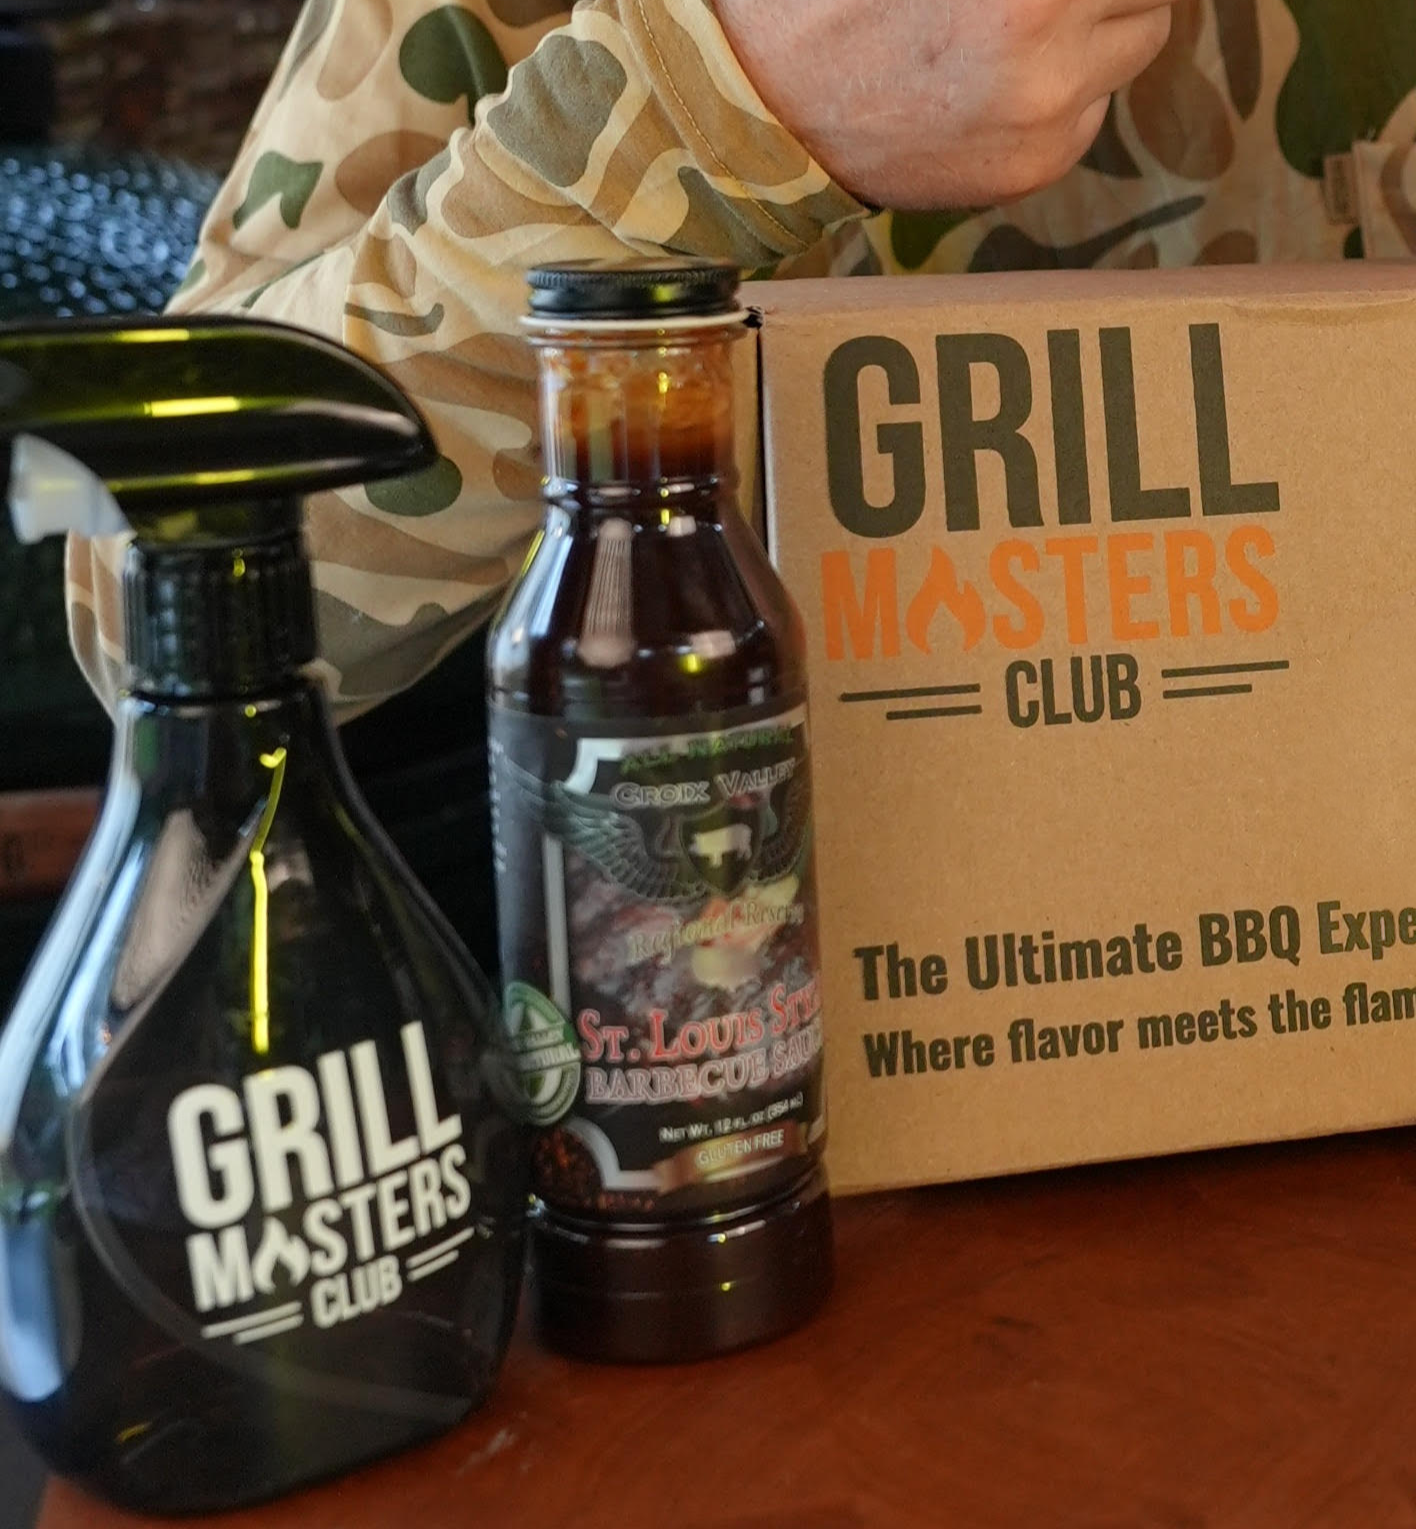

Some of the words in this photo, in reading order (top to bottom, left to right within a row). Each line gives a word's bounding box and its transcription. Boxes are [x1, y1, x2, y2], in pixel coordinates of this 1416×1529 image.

[822, 322, 1280, 539] GRILL
[821, 525, 1280, 661] MASTERS
[1005, 653, 1142, 728] CLUB
[610, 780, 711, 811] CROIX
[713, 757, 796, 798] VALLEY
[853, 942, 948, 1001] The
[964, 922, 1183, 992] Ultimate
[1199, 903, 1302, 968] BBQ
[650, 1008, 763, 1060] LOUIS
[861, 1028, 995, 1077] Where
[1008, 1015, 1125, 1065] flavor
[1137, 998, 1258, 1050] meets
[1267, 988, 1332, 1034] the
[584, 1048, 770, 1105] BARBECUE
[167, 1021, 464, 1229] GRILL
[696, 1136, 753, 1167] GLUTEN
[754, 1128, 785, 1150] FREE
[186, 1144, 472, 1312] MASTERS
[310, 1254, 403, 1329] CLUB
